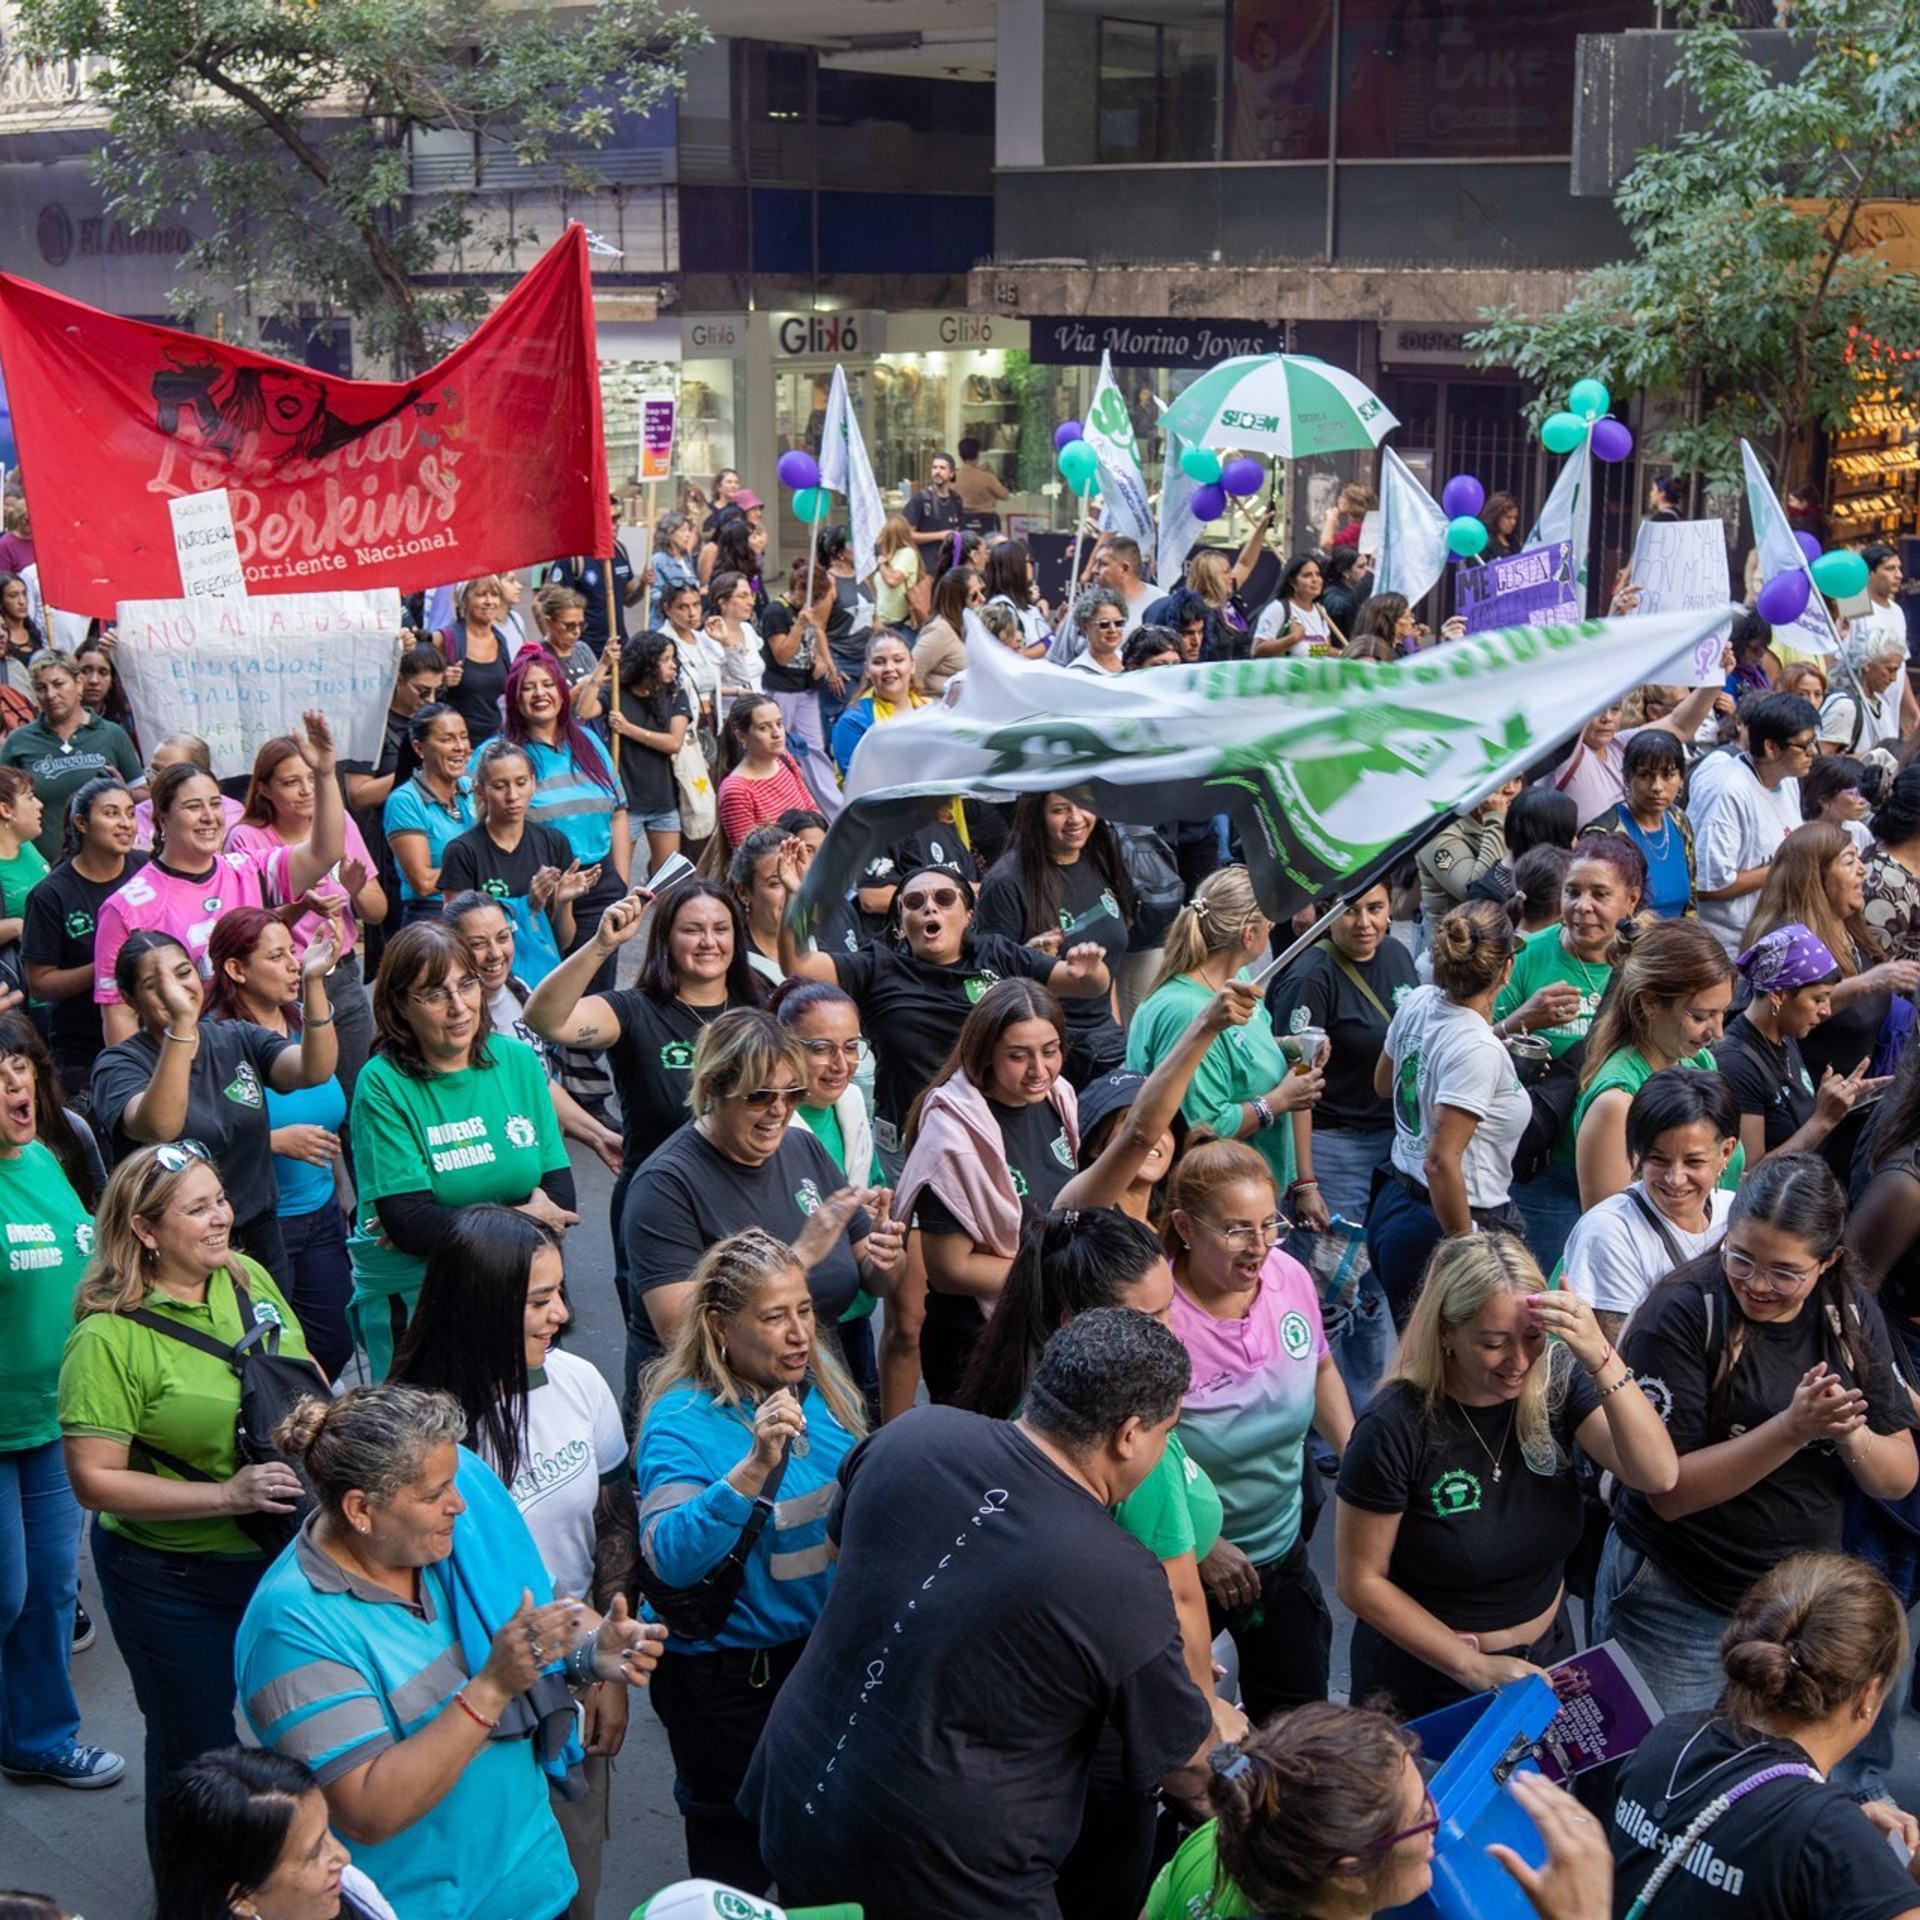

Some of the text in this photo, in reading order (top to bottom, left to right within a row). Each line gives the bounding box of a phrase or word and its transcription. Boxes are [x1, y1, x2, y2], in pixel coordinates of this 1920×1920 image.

[76, 216, 192, 255] El Ateneo
[692, 325, 735, 346] Glikó
[780, 316, 857, 354] Glikó
[939, 316, 992, 344] Glikó
[1055, 323, 1265, 361] Via Morino Joyas
[356, 527, 459, 566] Nacional
[1458, 554, 1549, 608] ME GUSTA
[219, 612, 247, 637] AL
[269, 609, 393, 633] AJUSTE
[179, 685, 272, 706] SALUD
[432, 1142, 496, 1173] SURRBAC
[1568, 1720, 1591, 1754] TODAS
[1586, 1735, 1606, 1761] TODO
